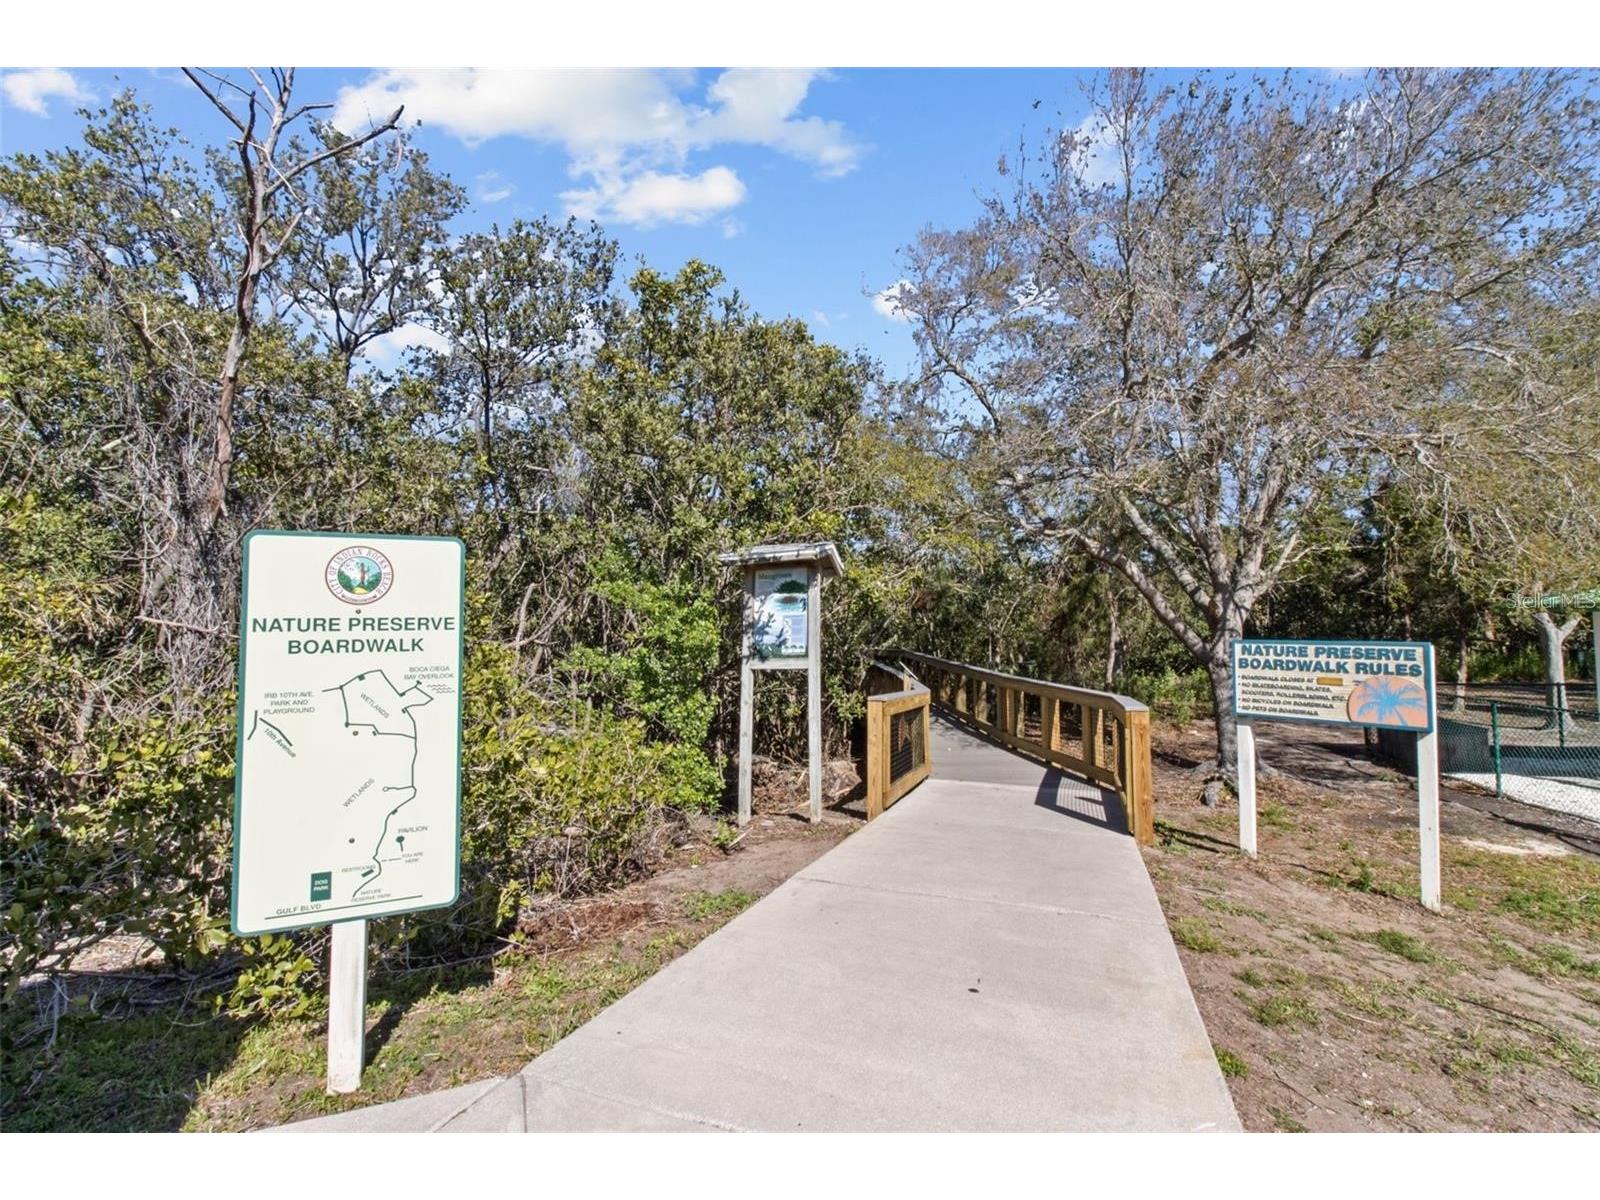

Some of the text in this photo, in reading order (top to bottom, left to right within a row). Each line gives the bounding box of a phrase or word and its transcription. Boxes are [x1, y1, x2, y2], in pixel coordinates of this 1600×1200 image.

[252, 616, 455, 633] NATURE PRESERVE
[288, 638, 424, 655] BOARDWALK
[1241, 644, 1417, 662] NATURE PRESERVE
[1238, 658, 1422, 677] BOARDWALK RULES
[263, 706, 316, 714] PLAYGROUND
[360, 692, 390, 720] WETLANDS
[342, 777, 376, 808] WETLANDS
[398, 825, 429, 834] PAVILION
[275, 903, 322, 915] GULF BLVD
